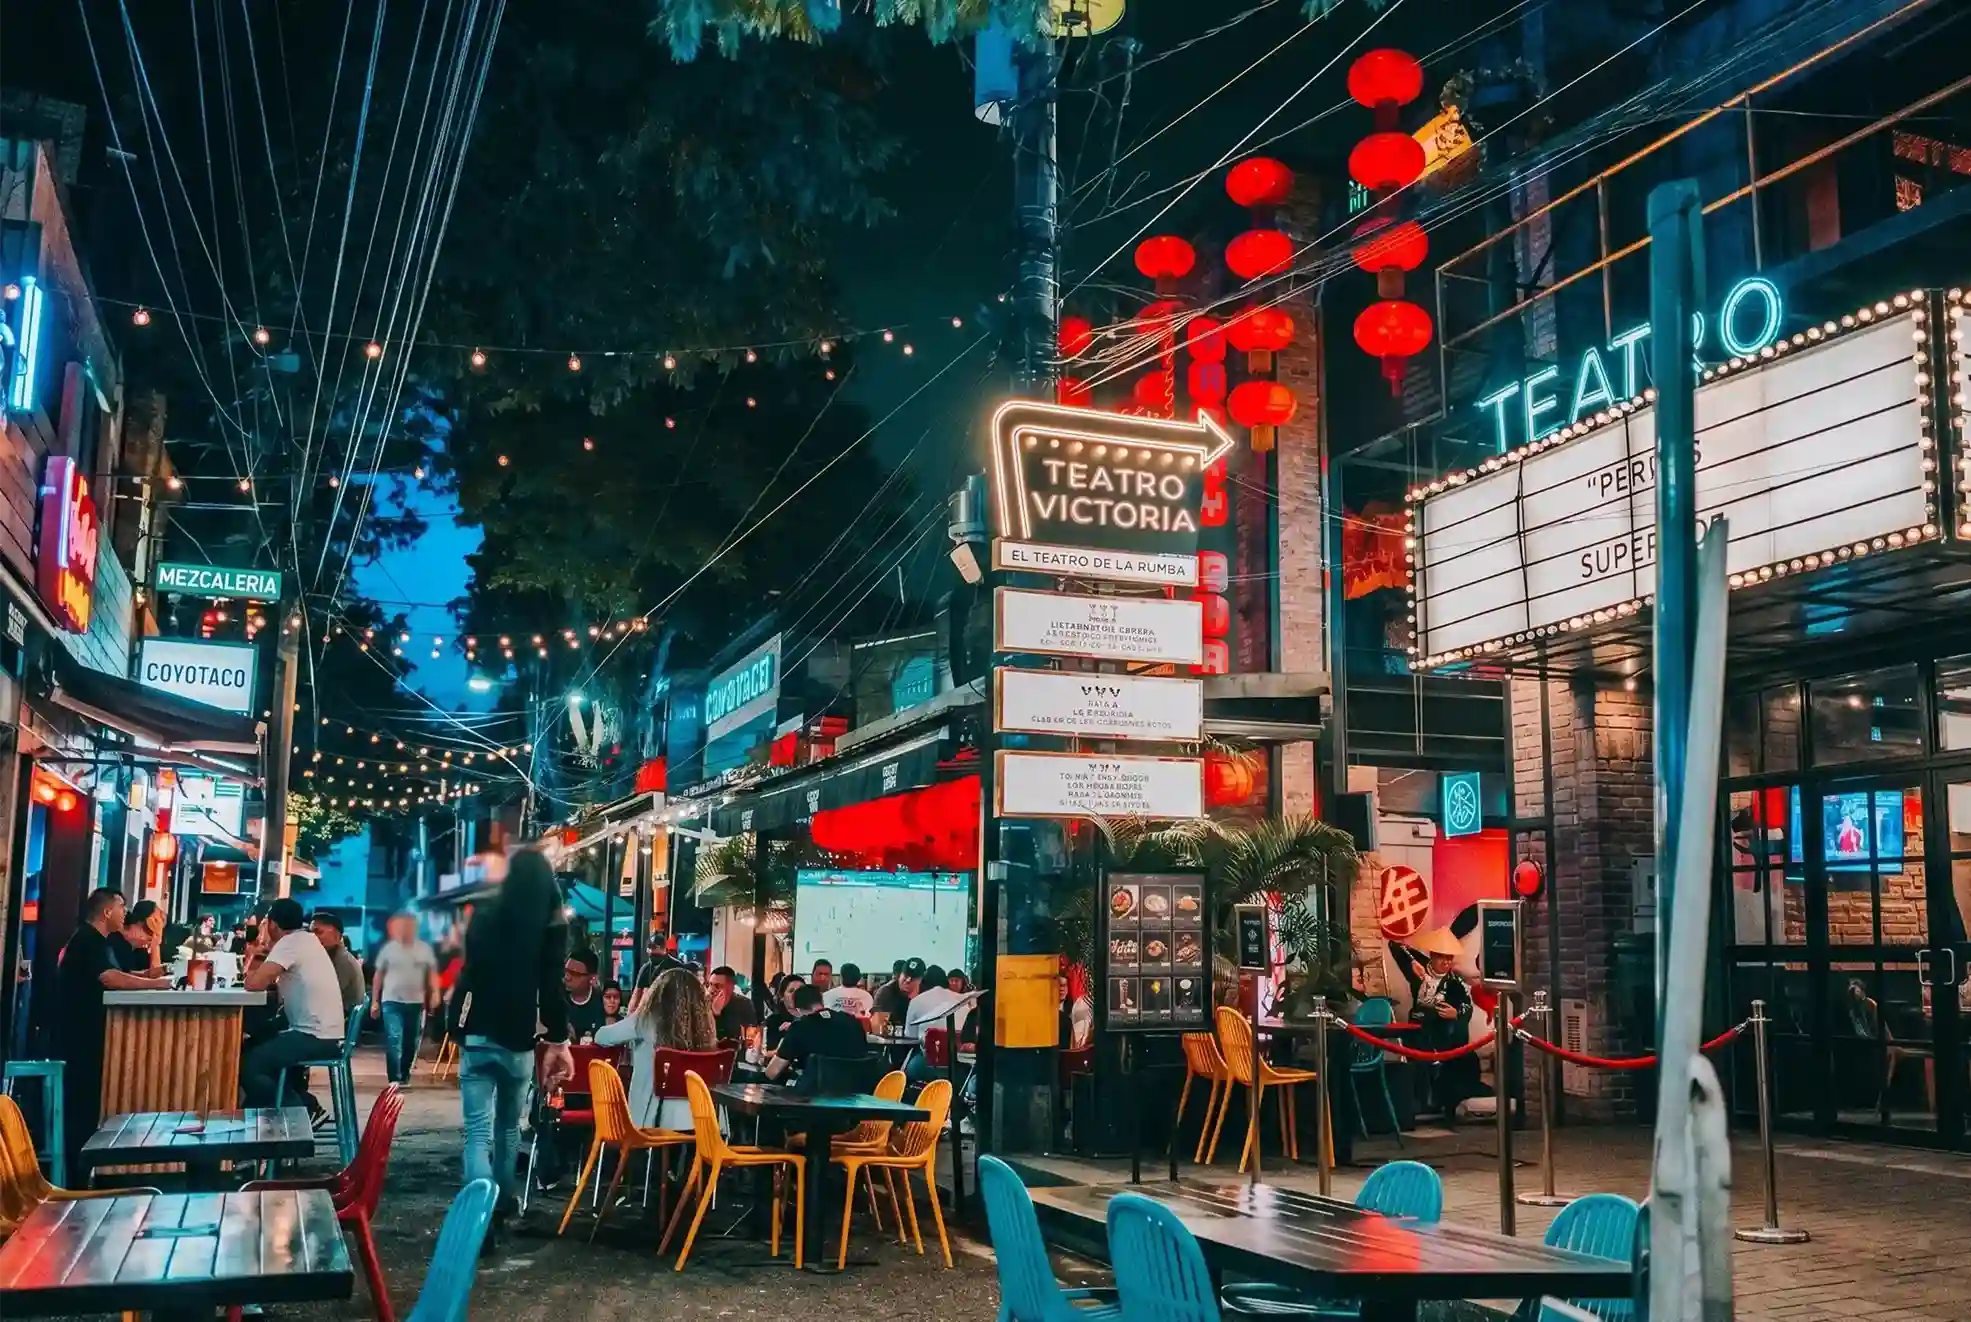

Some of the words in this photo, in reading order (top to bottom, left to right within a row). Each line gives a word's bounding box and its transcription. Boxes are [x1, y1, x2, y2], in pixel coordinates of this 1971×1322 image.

[1042, 459, 1185, 500] TEATRO
[1032, 490, 1196, 533] VICTORIA
[1011, 550, 1028, 562] EL
[1033, 552, 1089, 567] TEATRO
[1093, 557, 1111, 568] DE
[1116, 560, 1133, 571] LA
[1137, 561, 1186, 576] RUMBA
[159, 567, 277, 594] MEZCALERIA
[147, 662, 246, 688] COYOTACO
